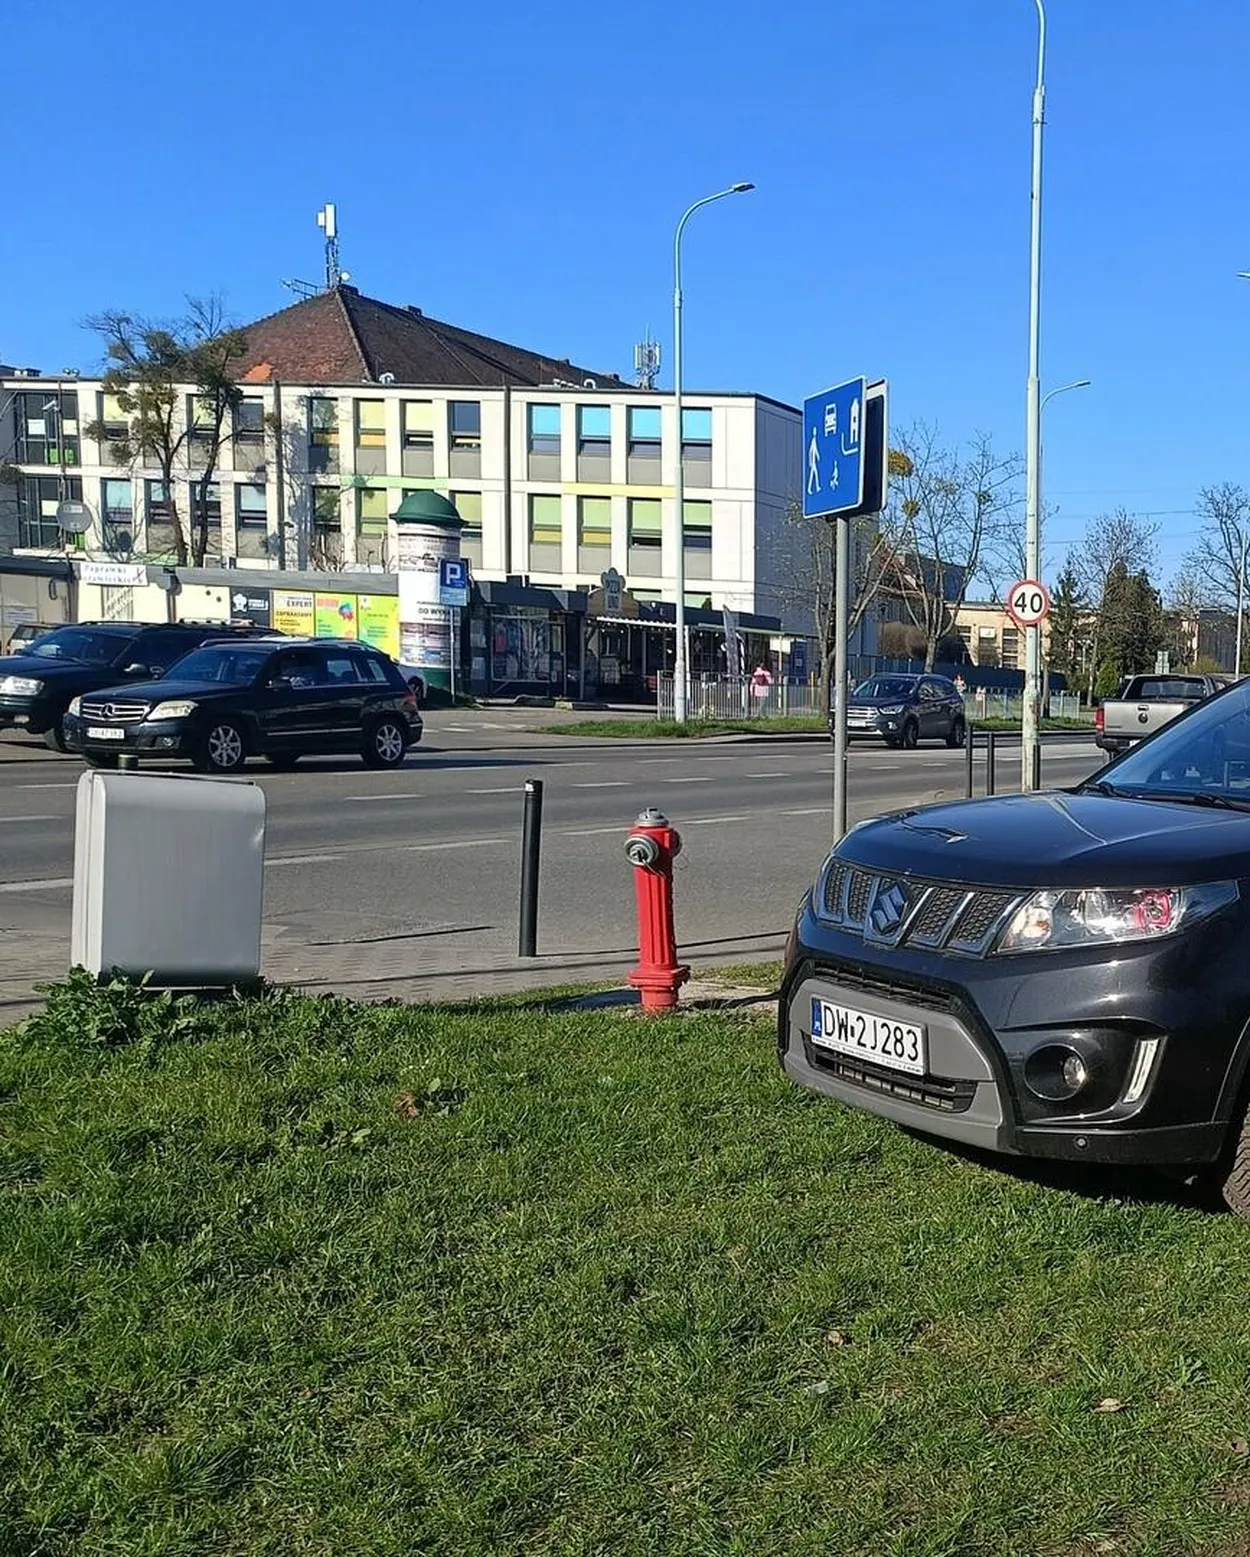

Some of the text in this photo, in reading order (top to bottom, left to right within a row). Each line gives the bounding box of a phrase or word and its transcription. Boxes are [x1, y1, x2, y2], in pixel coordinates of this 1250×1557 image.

[446, 563, 461, 585] P
[1014, 592, 1043, 613] 40
[823, 1005, 849, 1042] DW
[856, 1015, 919, 1062] 2J283
